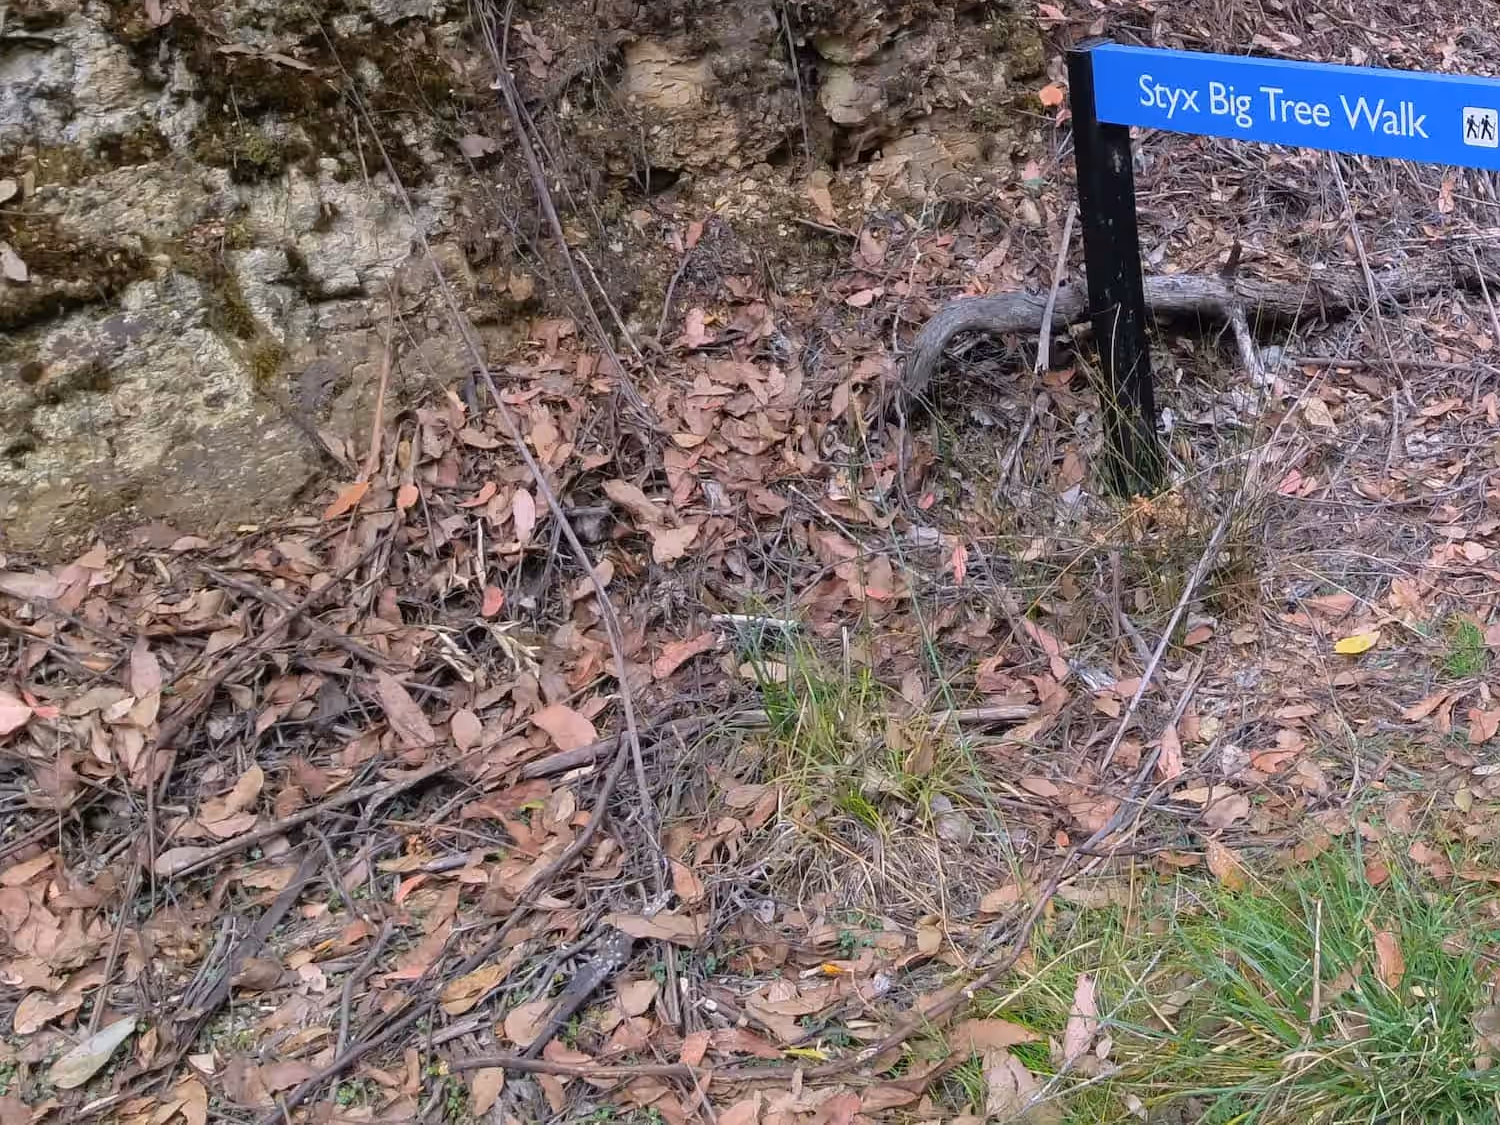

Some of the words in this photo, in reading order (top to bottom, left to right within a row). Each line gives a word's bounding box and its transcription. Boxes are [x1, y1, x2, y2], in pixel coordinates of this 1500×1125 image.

[1139, 74, 1200, 119] Styx
[1209, 81, 1254, 129] Big
[1259, 87, 1331, 127] Tree
[1339, 95, 1429, 139] Walk
